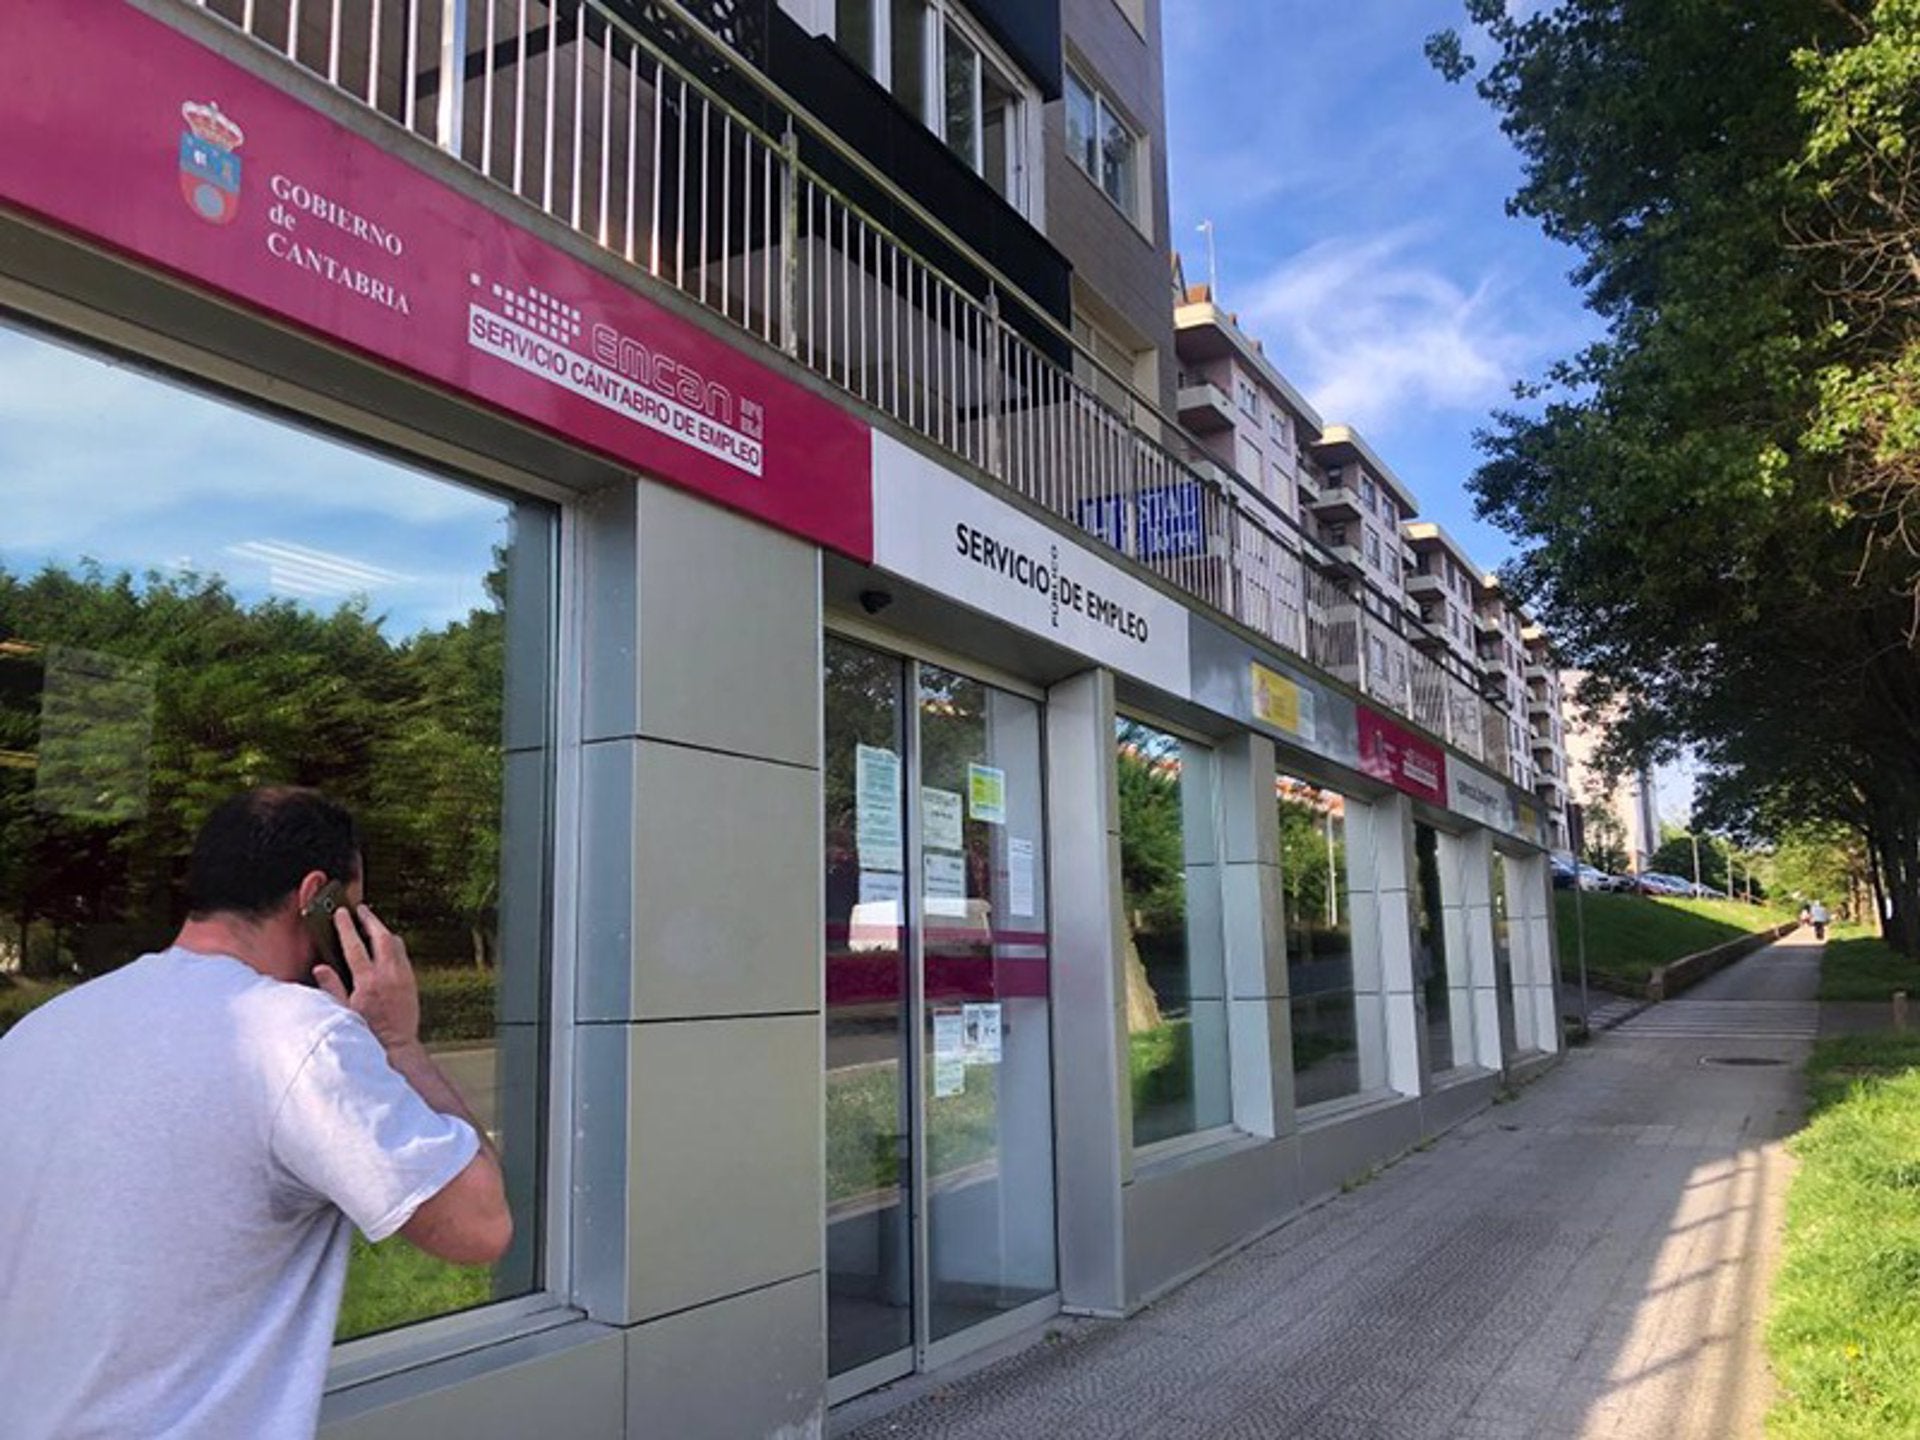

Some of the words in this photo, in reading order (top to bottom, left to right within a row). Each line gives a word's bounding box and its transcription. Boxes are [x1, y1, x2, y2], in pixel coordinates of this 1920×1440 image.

[269, 206, 296, 231] de
[270, 174, 402, 256] GOBIERNO
[267, 232, 410, 315] CANTABRIA
[471, 313, 568, 376] SERVICIO
[571, 362, 670, 425] CÁNTABRO
[673, 410, 696, 438] DE
[699, 424, 760, 467] EMPLEO
[956, 522, 1050, 594] SERVICIO
[1060, 575, 1083, 612] DE
[1086, 589, 1148, 643] EMPLEO
